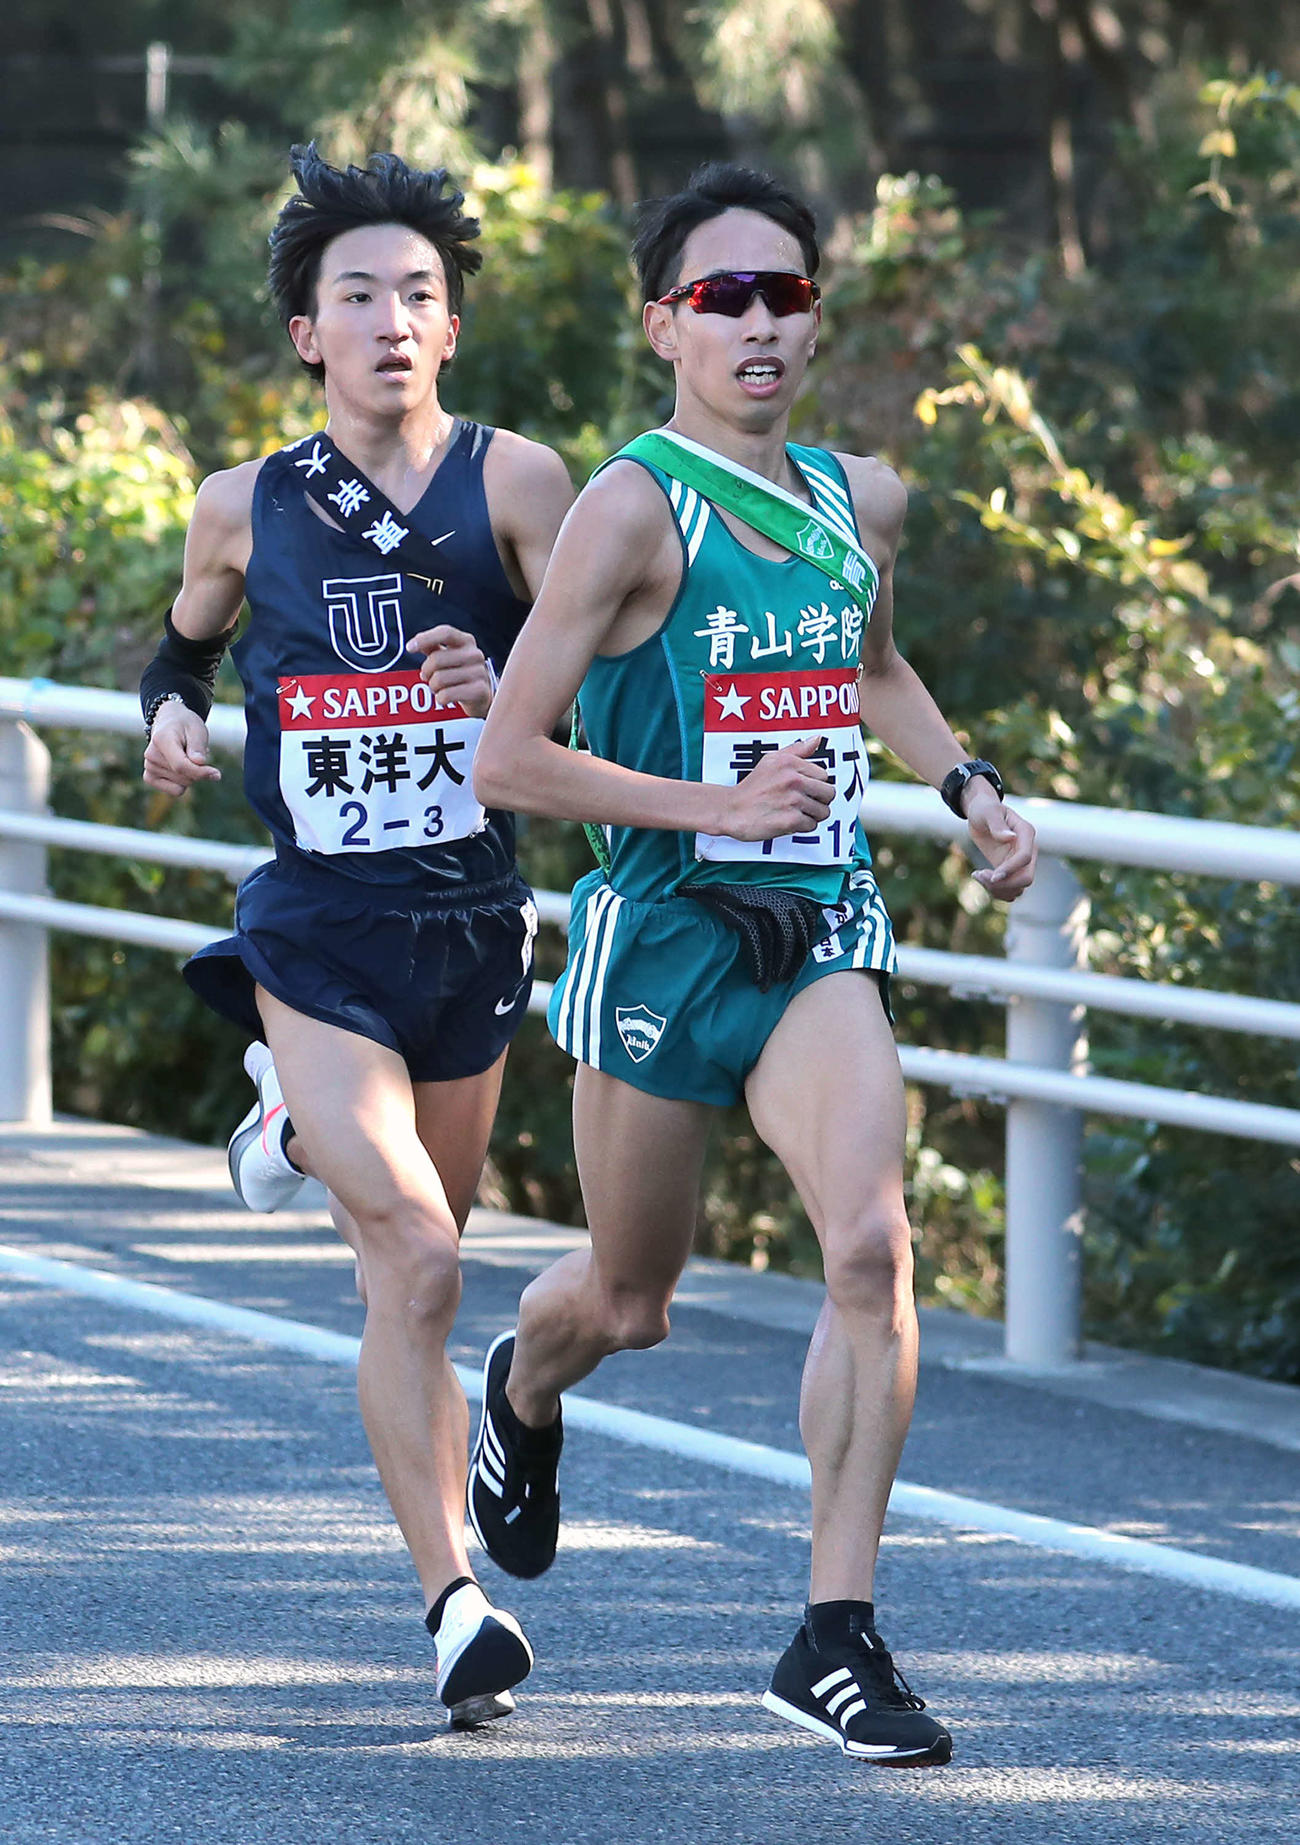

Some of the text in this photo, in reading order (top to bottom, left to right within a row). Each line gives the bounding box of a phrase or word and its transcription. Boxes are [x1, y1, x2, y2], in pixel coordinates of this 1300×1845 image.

[693, 602, 865, 669] 青山学院
[323, 682, 457, 719] SAPPO
[301, 728, 465, 798] 東洋大
